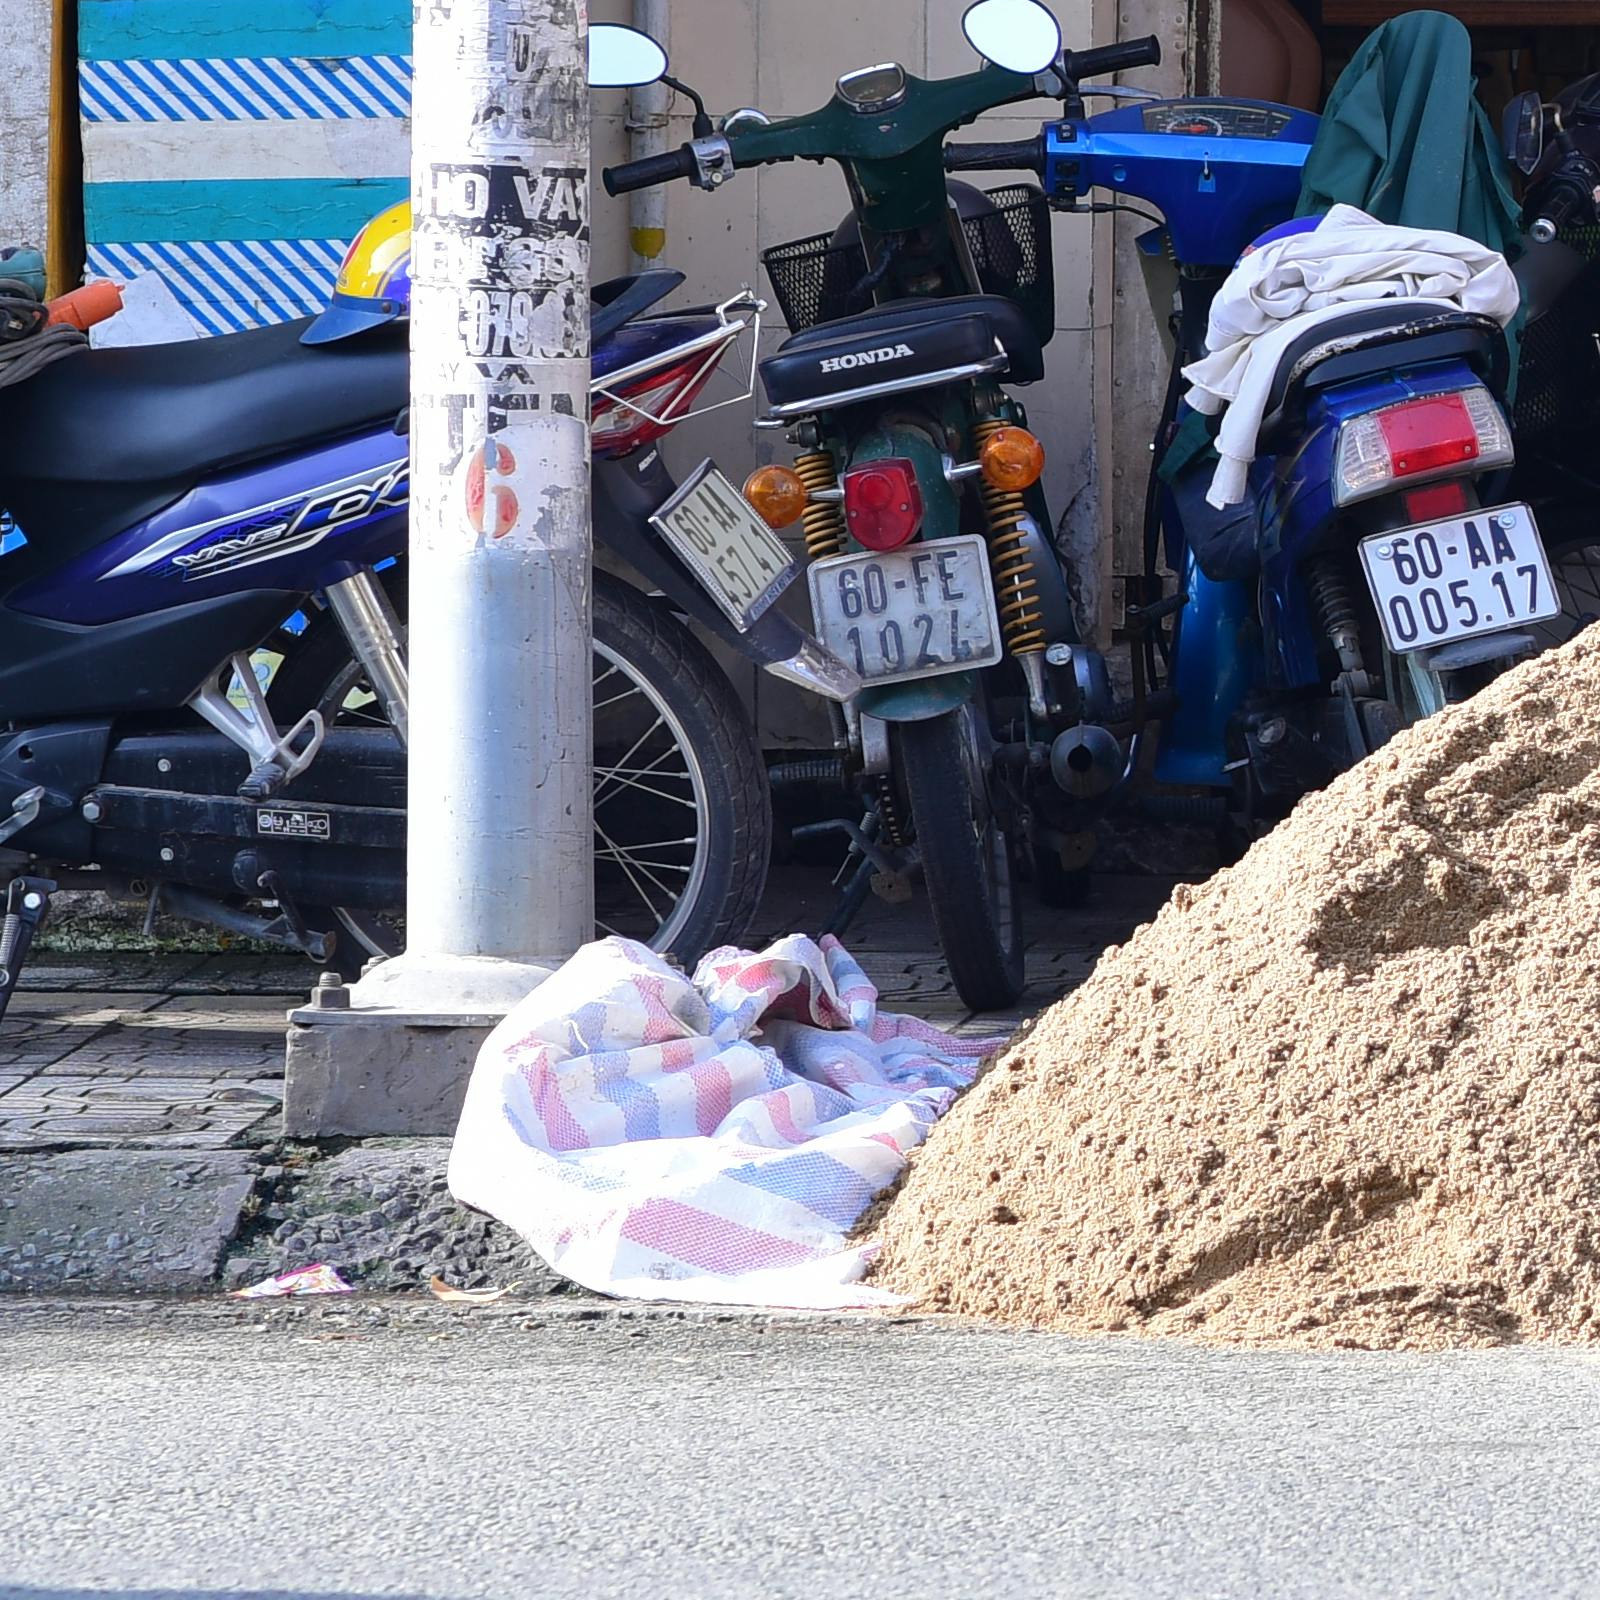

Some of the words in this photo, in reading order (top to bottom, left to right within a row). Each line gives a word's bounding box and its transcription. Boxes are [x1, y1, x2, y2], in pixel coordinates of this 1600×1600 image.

[820, 343, 915, 374] HONDA
[672, 480, 742, 557] 60-AA
[1391, 515, 1517, 586] 60-AA
[838, 550, 965, 619] 60-FE
[1388, 563, 1539, 643] 005.17
